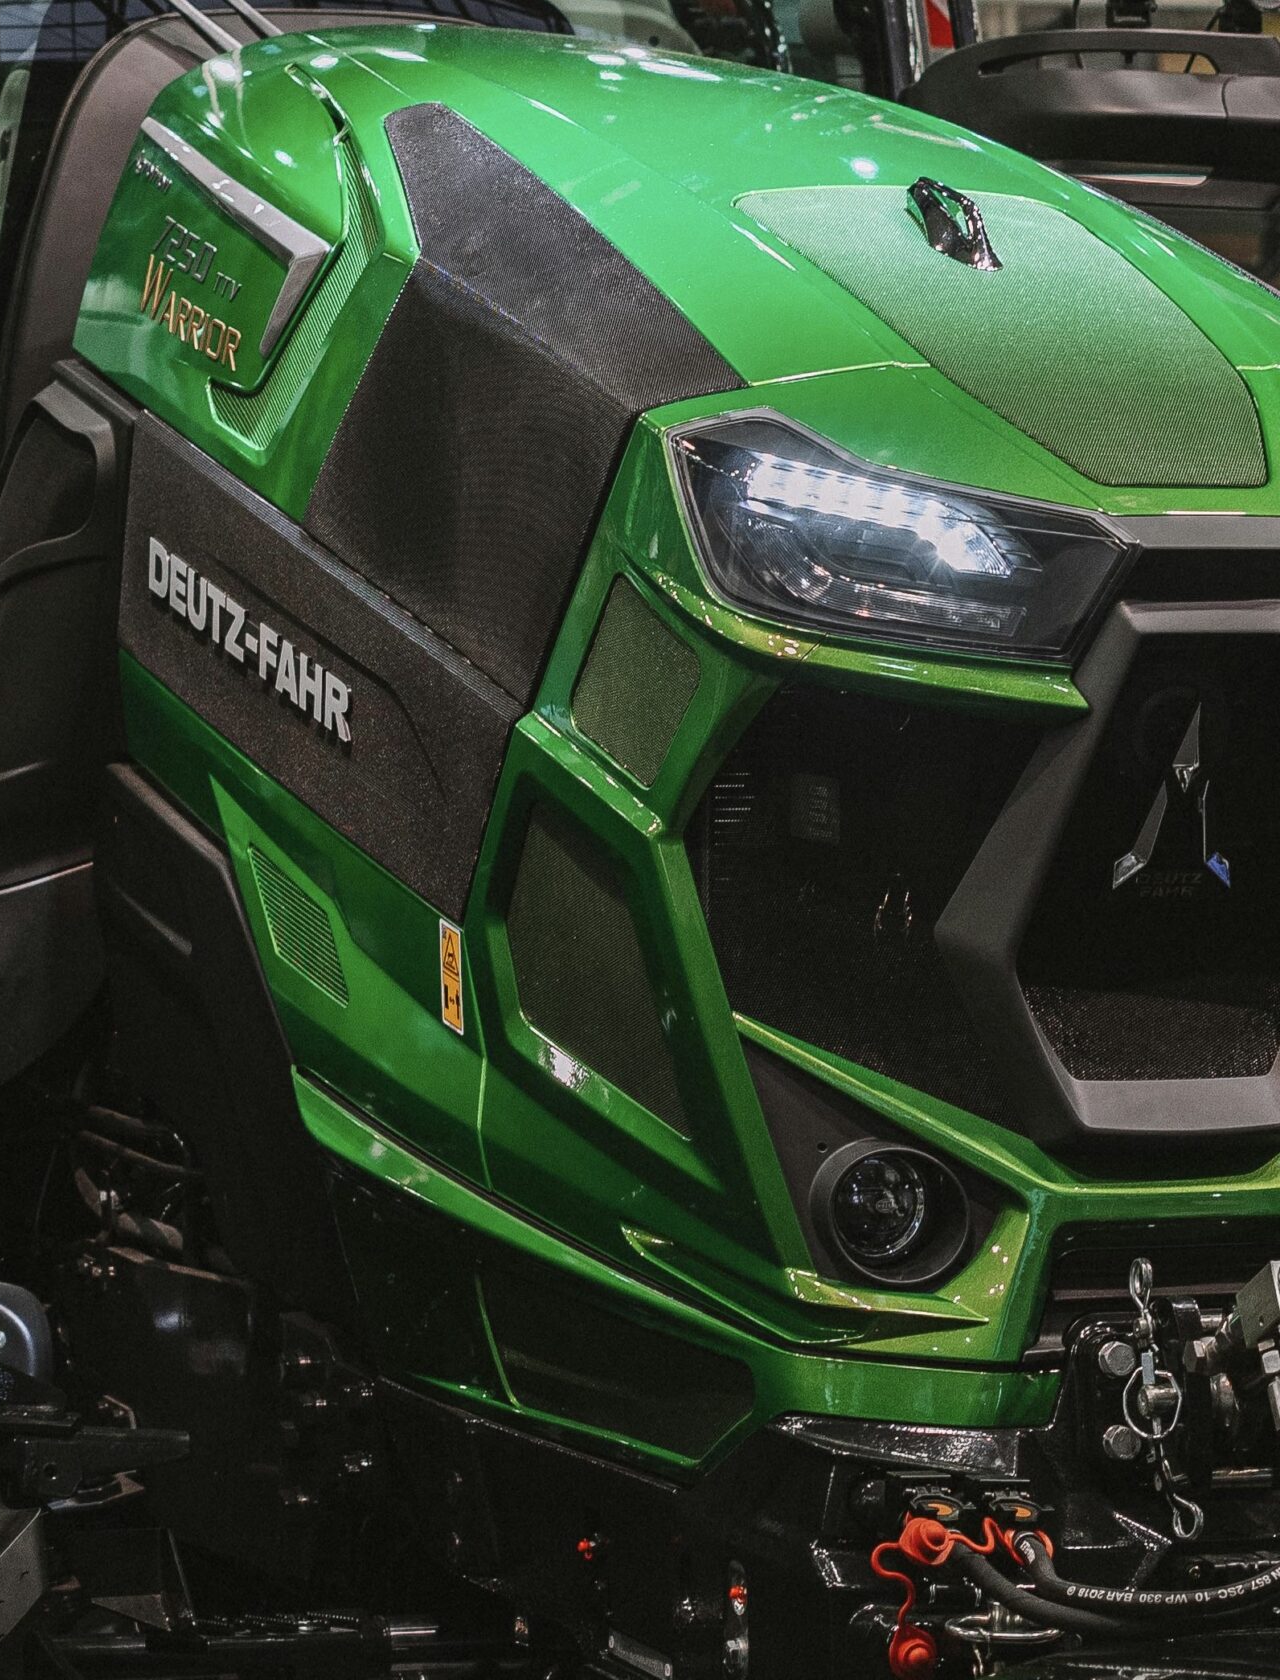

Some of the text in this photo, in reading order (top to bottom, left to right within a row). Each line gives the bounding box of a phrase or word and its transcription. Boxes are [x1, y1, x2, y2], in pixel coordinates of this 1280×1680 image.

[152, 215, 242, 303] 7250 TTV
[148, 536, 352, 743] DEUTZ-FAHR
[1250, 1574, 1272, 1591] 857
[1106, 1590, 1133, 1602] BAR
[1138, 1593, 1162, 1603] 330
[1194, 1591, 1211, 1602] 10
[1217, 1584, 1245, 1599] 2SC
[1165, 1593, 1188, 1605] WP
